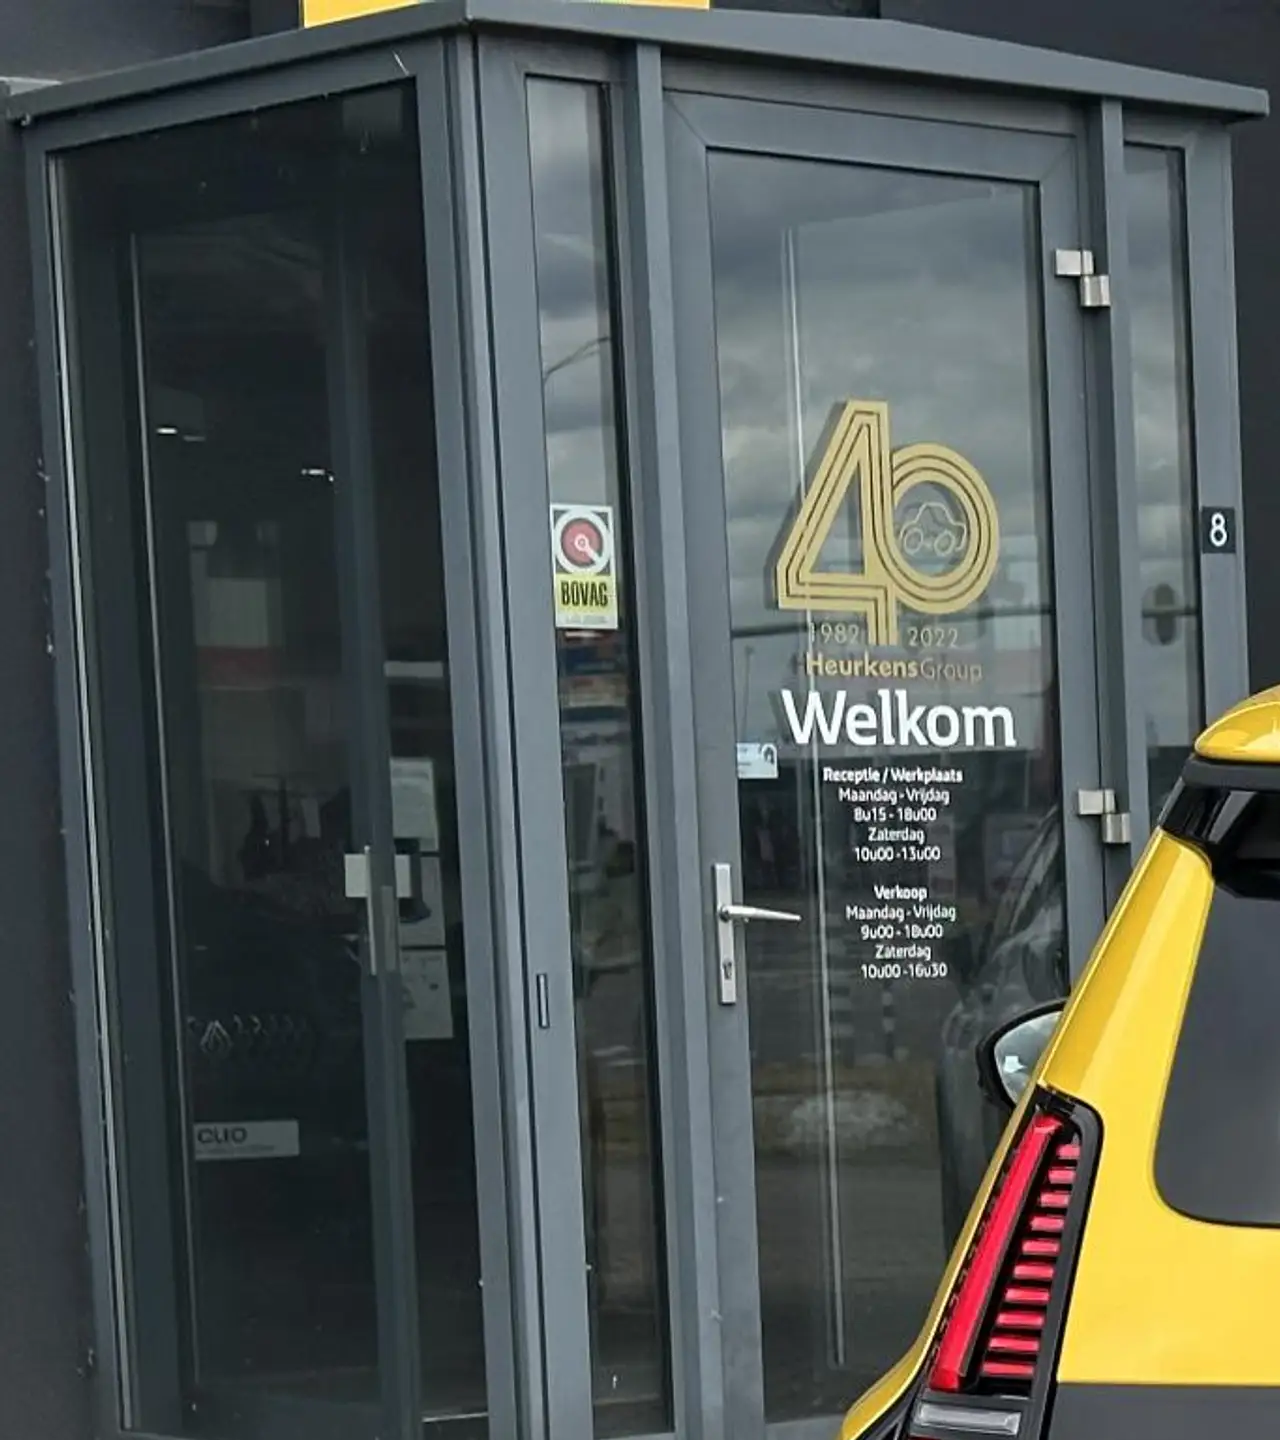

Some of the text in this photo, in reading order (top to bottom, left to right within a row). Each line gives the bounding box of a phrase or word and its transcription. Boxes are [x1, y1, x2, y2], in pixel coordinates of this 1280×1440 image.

[1209, 511, 1228, 548] 8
[560, 580, 609, 608] BOVAG
[809, 621, 959, 648] 1982 2022
[781, 687, 1018, 748] Welkom
[822, 766, 880, 784] Receptie
[890, 766, 964, 785] Werkplaats
[838, 787, 898, 806] Maandag
[905, 787, 951, 806] Vrijdag
[853, 806, 887, 822] 8u15
[897, 806, 937, 822] 18u00
[867, 826, 926, 845] Zaterdag
[854, 846, 895, 862] 10u00
[902, 845, 941, 862] 13u00
[873, 884, 928, 903] Verkoop
[845, 904, 905, 923] Maandag
[912, 903, 957, 922] Vrijdag
[860, 924, 895, 940] 9u00
[904, 923, 944, 939] 18u00
[874, 943, 932, 961] Zaterdag
[861, 963, 901, 979] 10u00
